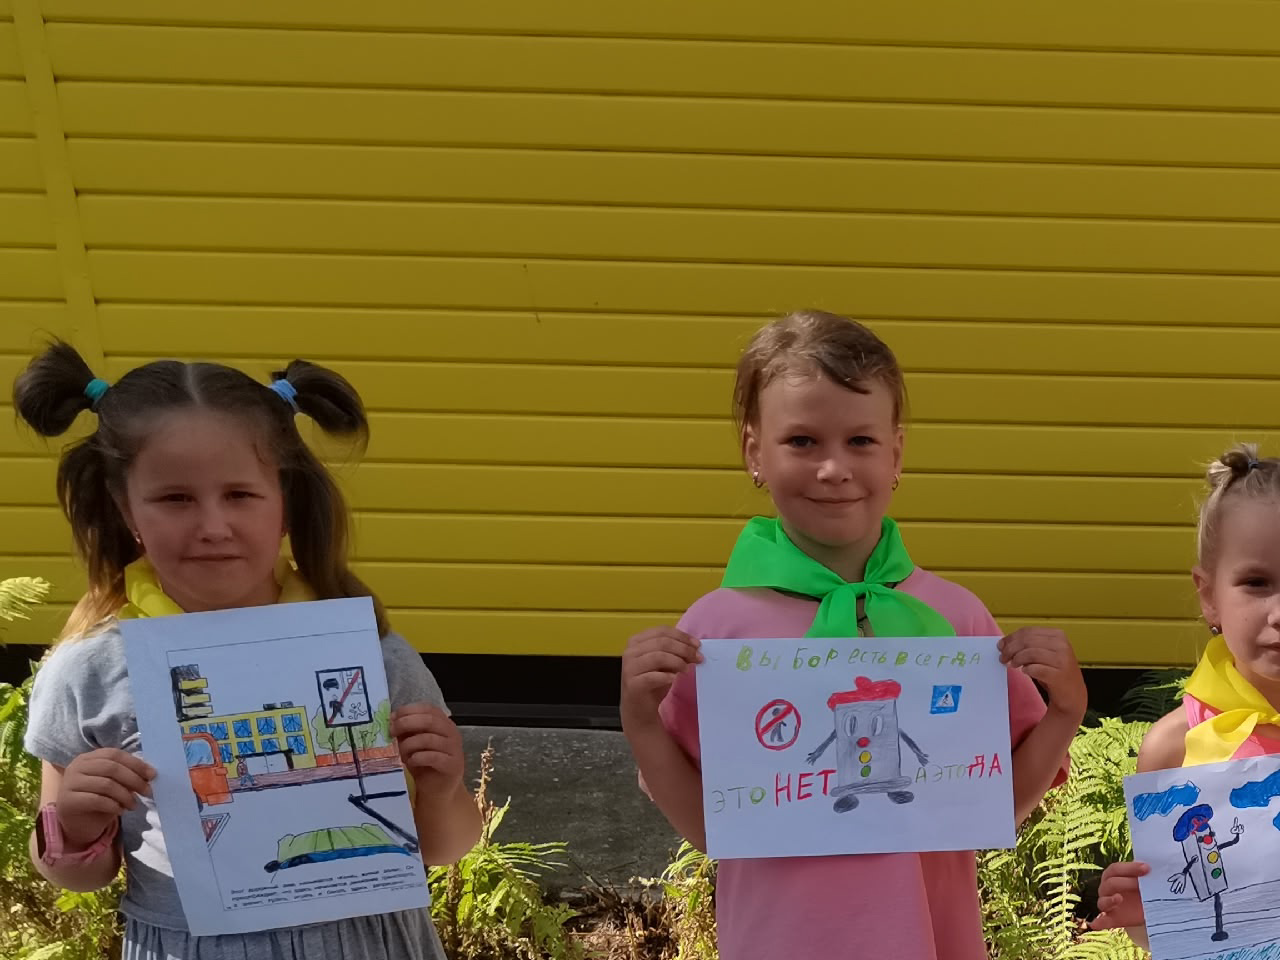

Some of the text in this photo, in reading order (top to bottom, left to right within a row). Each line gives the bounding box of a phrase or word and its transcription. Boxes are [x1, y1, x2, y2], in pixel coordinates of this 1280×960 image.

[931, 764, 966, 783] ЭТО
[966, 752, 1003, 779] ДА
[711, 769, 837, 813] ЭТО НЕТ
